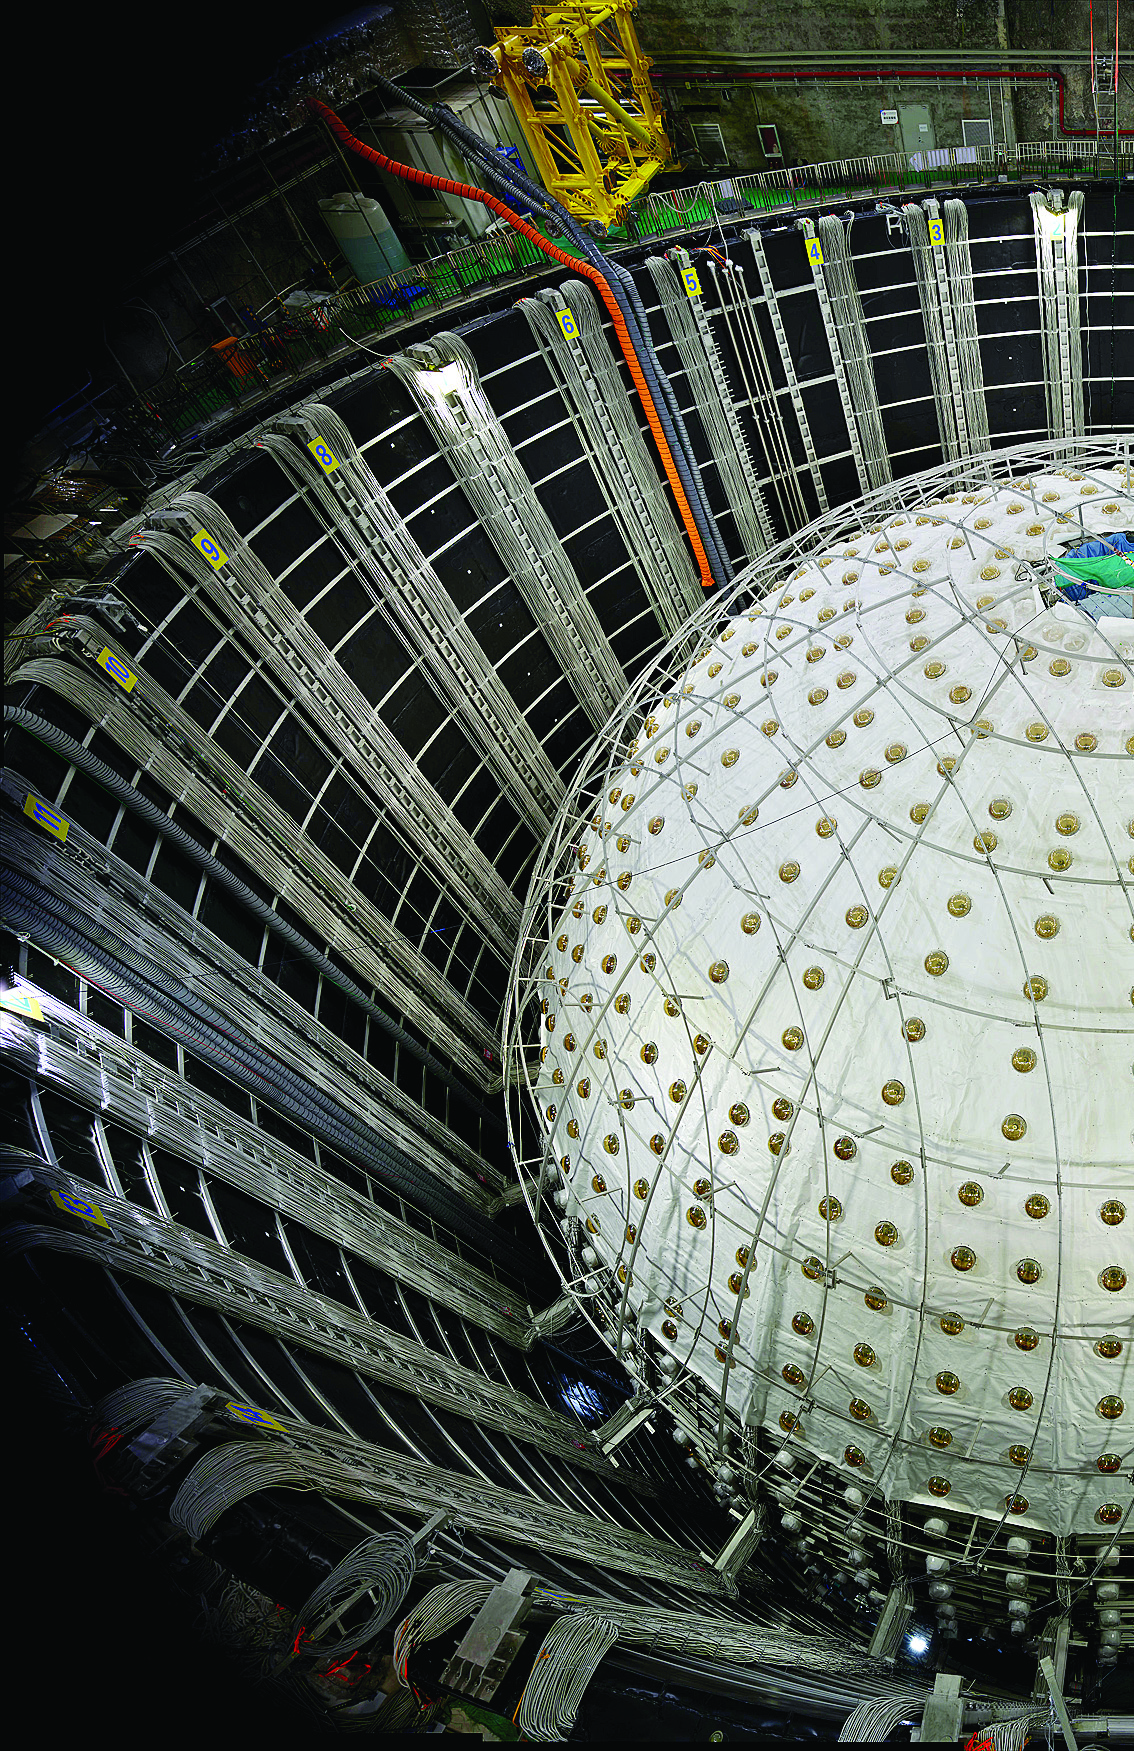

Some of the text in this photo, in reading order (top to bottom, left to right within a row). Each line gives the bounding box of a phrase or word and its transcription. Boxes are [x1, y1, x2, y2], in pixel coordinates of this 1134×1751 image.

[931, 225, 941, 240] 3
[811, 243, 820, 259] 4
[685, 273, 696, 291] 5
[562, 315, 574, 333] 6
[315, 444, 332, 465] 8
[200, 538, 220, 562] 9
[105, 656, 130, 684] 10
[32, 801, 62, 831] 11
[58, 1192, 97, 1220] 13
